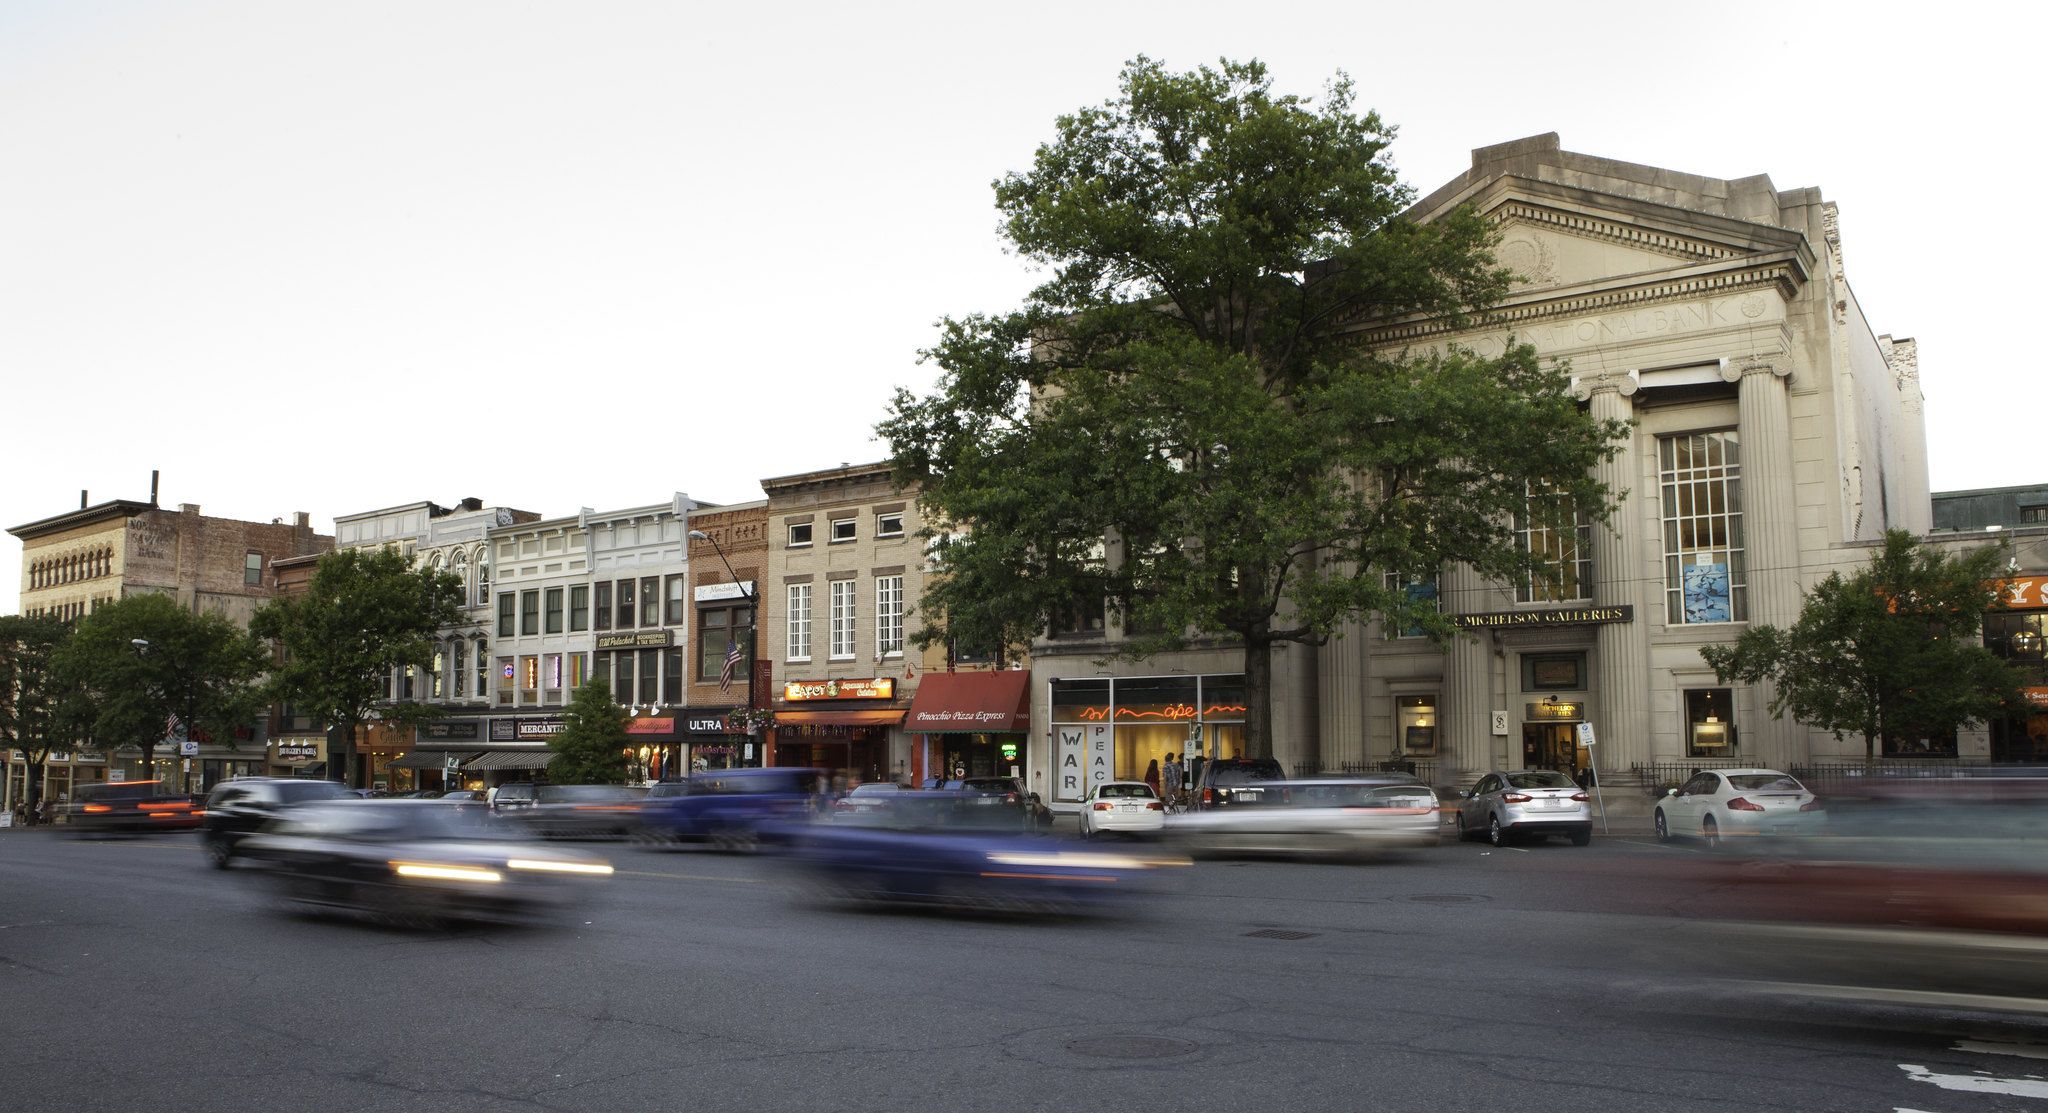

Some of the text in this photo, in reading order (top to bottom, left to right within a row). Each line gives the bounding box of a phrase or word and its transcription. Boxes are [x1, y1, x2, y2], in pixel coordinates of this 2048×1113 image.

[1520, 300, 1730, 348] NATIONAL BANK
[1465, 612, 1540, 627] MICHELSON
[1546, 608, 1623, 623] GALLERIES
[689, 720, 722, 730] ULTRA
[917, 710, 952, 720] Pinocchio
[952, 711, 973, 720] Pizza
[975, 711, 1006, 722] Express
[1095, 726, 1105, 780] PEAC
